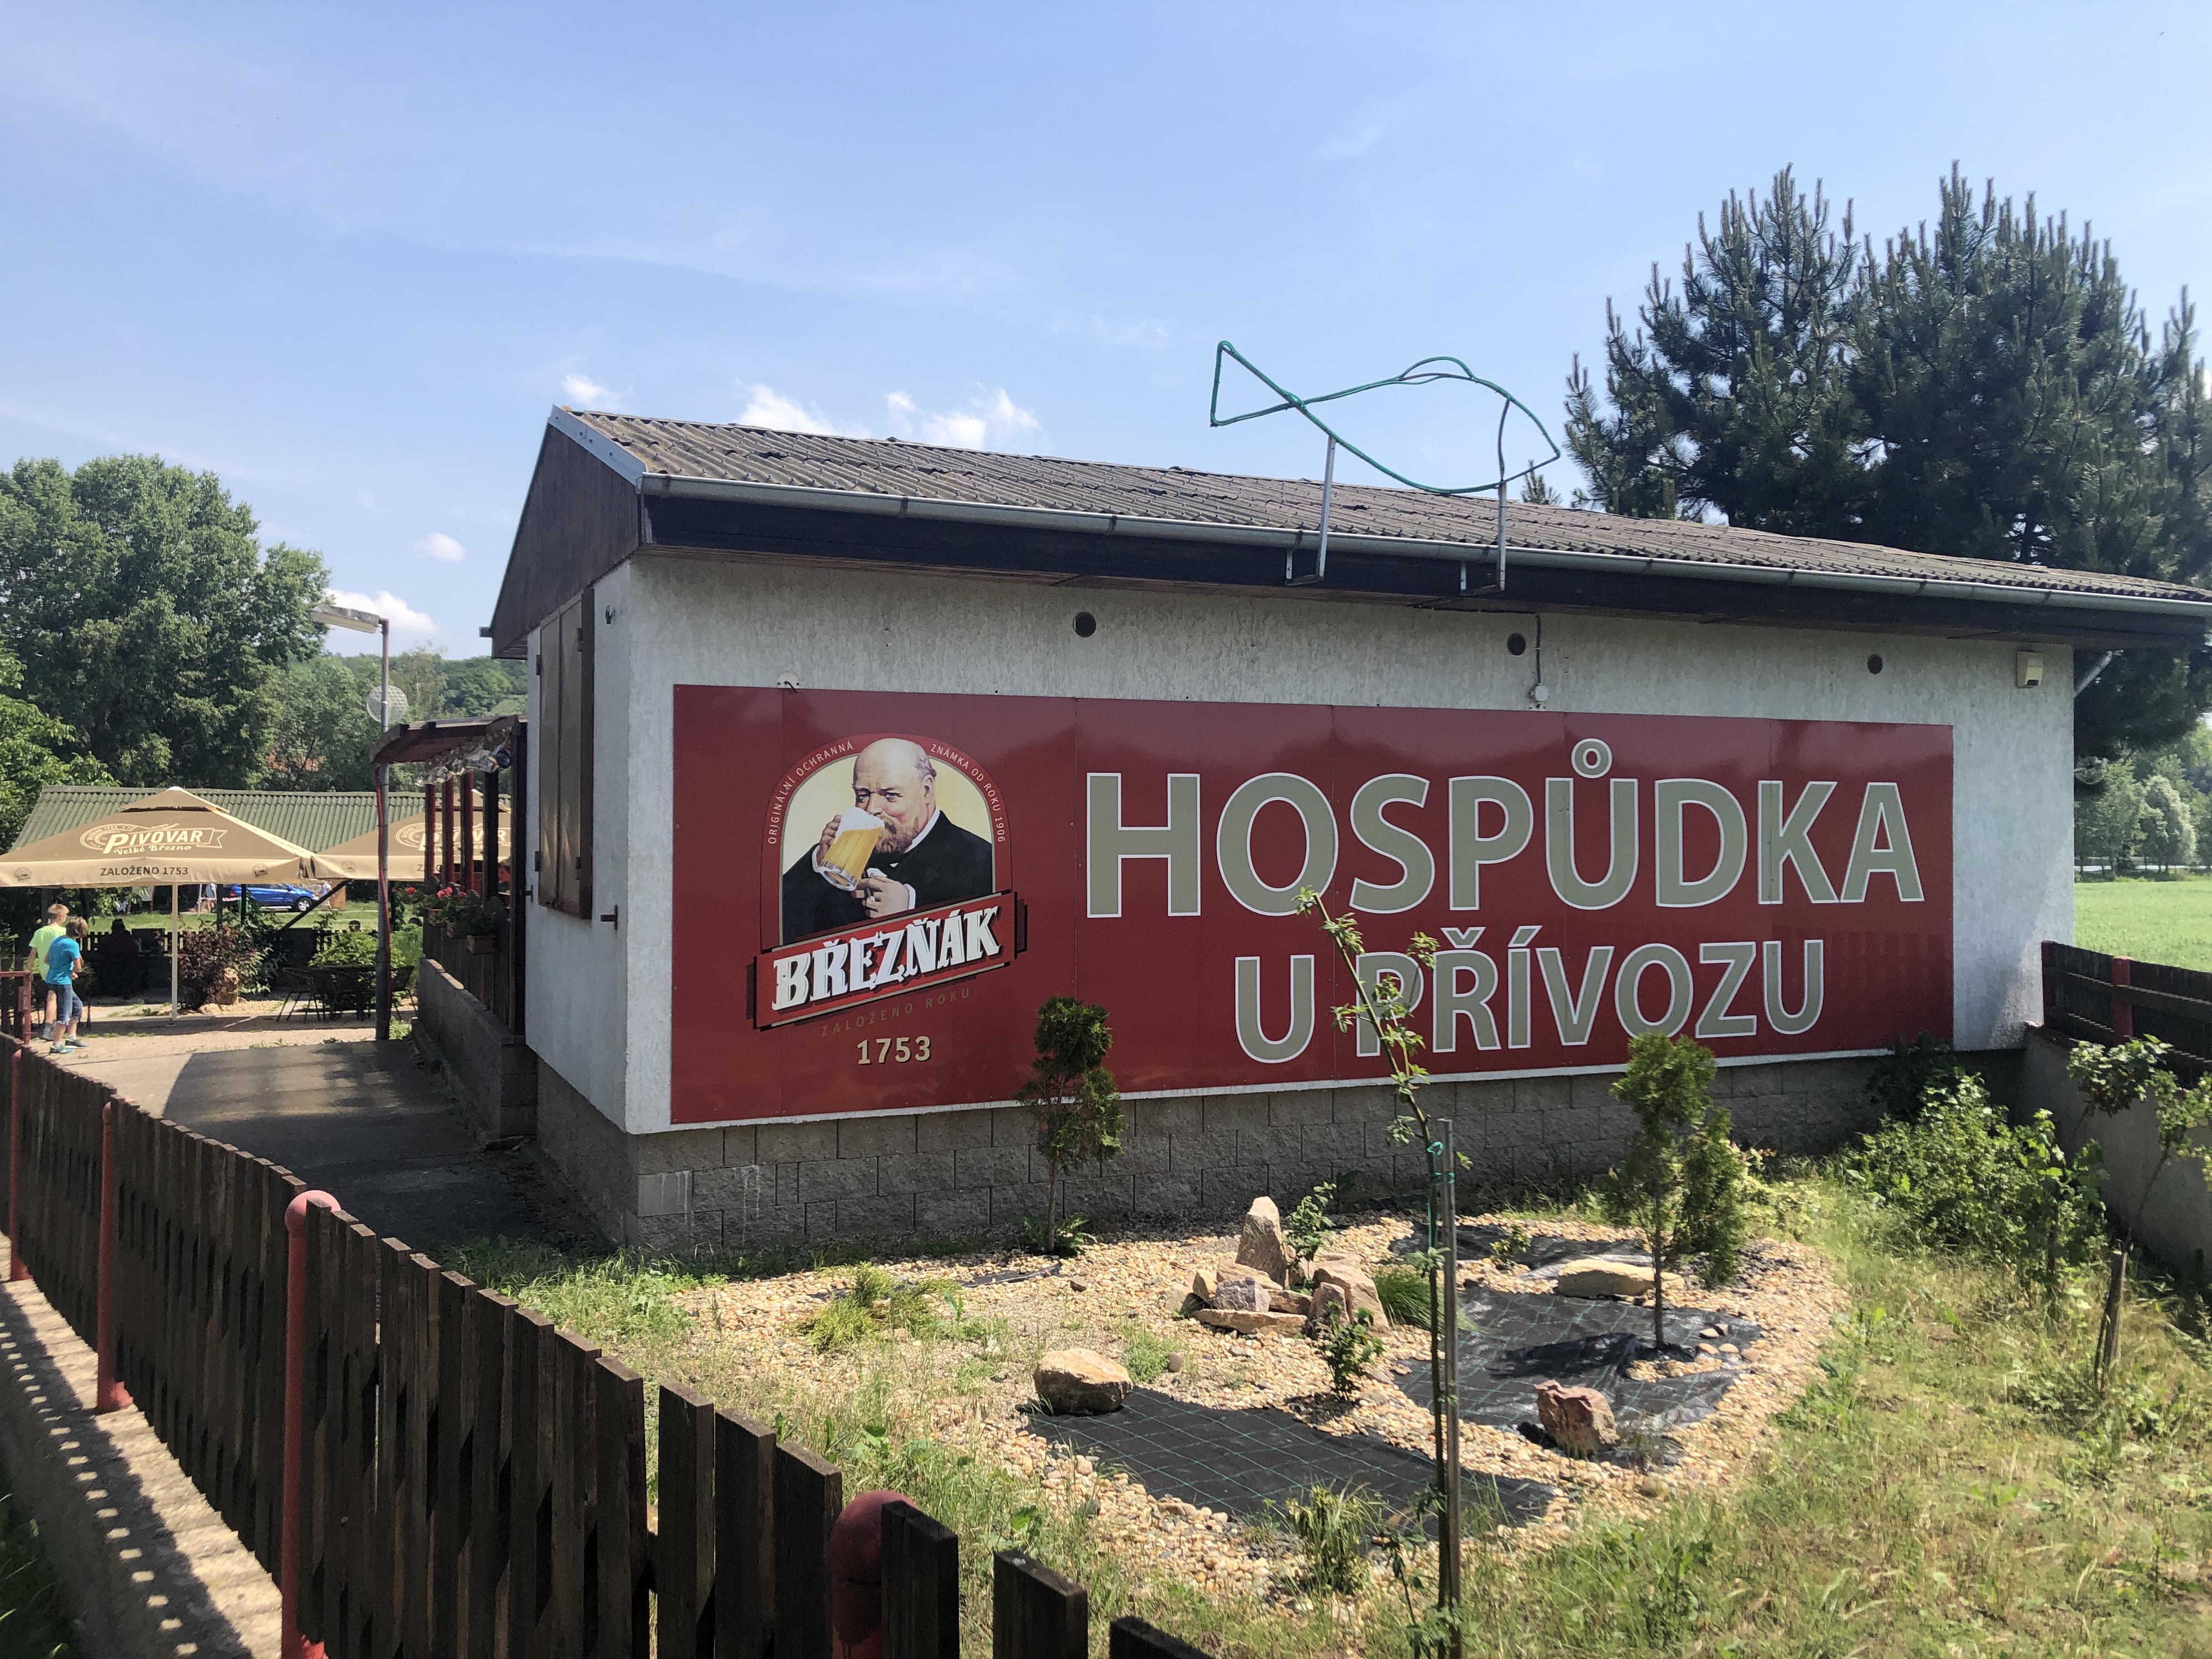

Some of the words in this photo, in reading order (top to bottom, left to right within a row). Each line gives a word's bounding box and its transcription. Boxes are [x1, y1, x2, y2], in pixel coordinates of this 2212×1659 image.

[768, 775, 796, 844] ORIGINÁLNÍ
[796, 740, 854, 777] OCHRANNÁ
[930, 744, 969, 770] ZNÁMKA
[971, 768, 984, 782] OD
[984, 782, 1001, 811] ROKU
[995, 816, 1006, 842] 1906
[1087, 738, 1925, 918] HOSPŮDKA
[100, 865, 160, 877] ZALOŽENO
[162, 867, 189, 875] 1753
[103, 830, 203, 854] PIVOVAR
[771, 906, 1000, 1011] BŘEZŇÁK
[1235, 954, 1315, 1064] U
[1355, 925, 1824, 1057] PŘÍVOZU
[821, 1003, 914, 1037] ZALOŽENO
[925, 988, 971, 1010] ROKU
[857, 1035, 931, 1065] 1753
